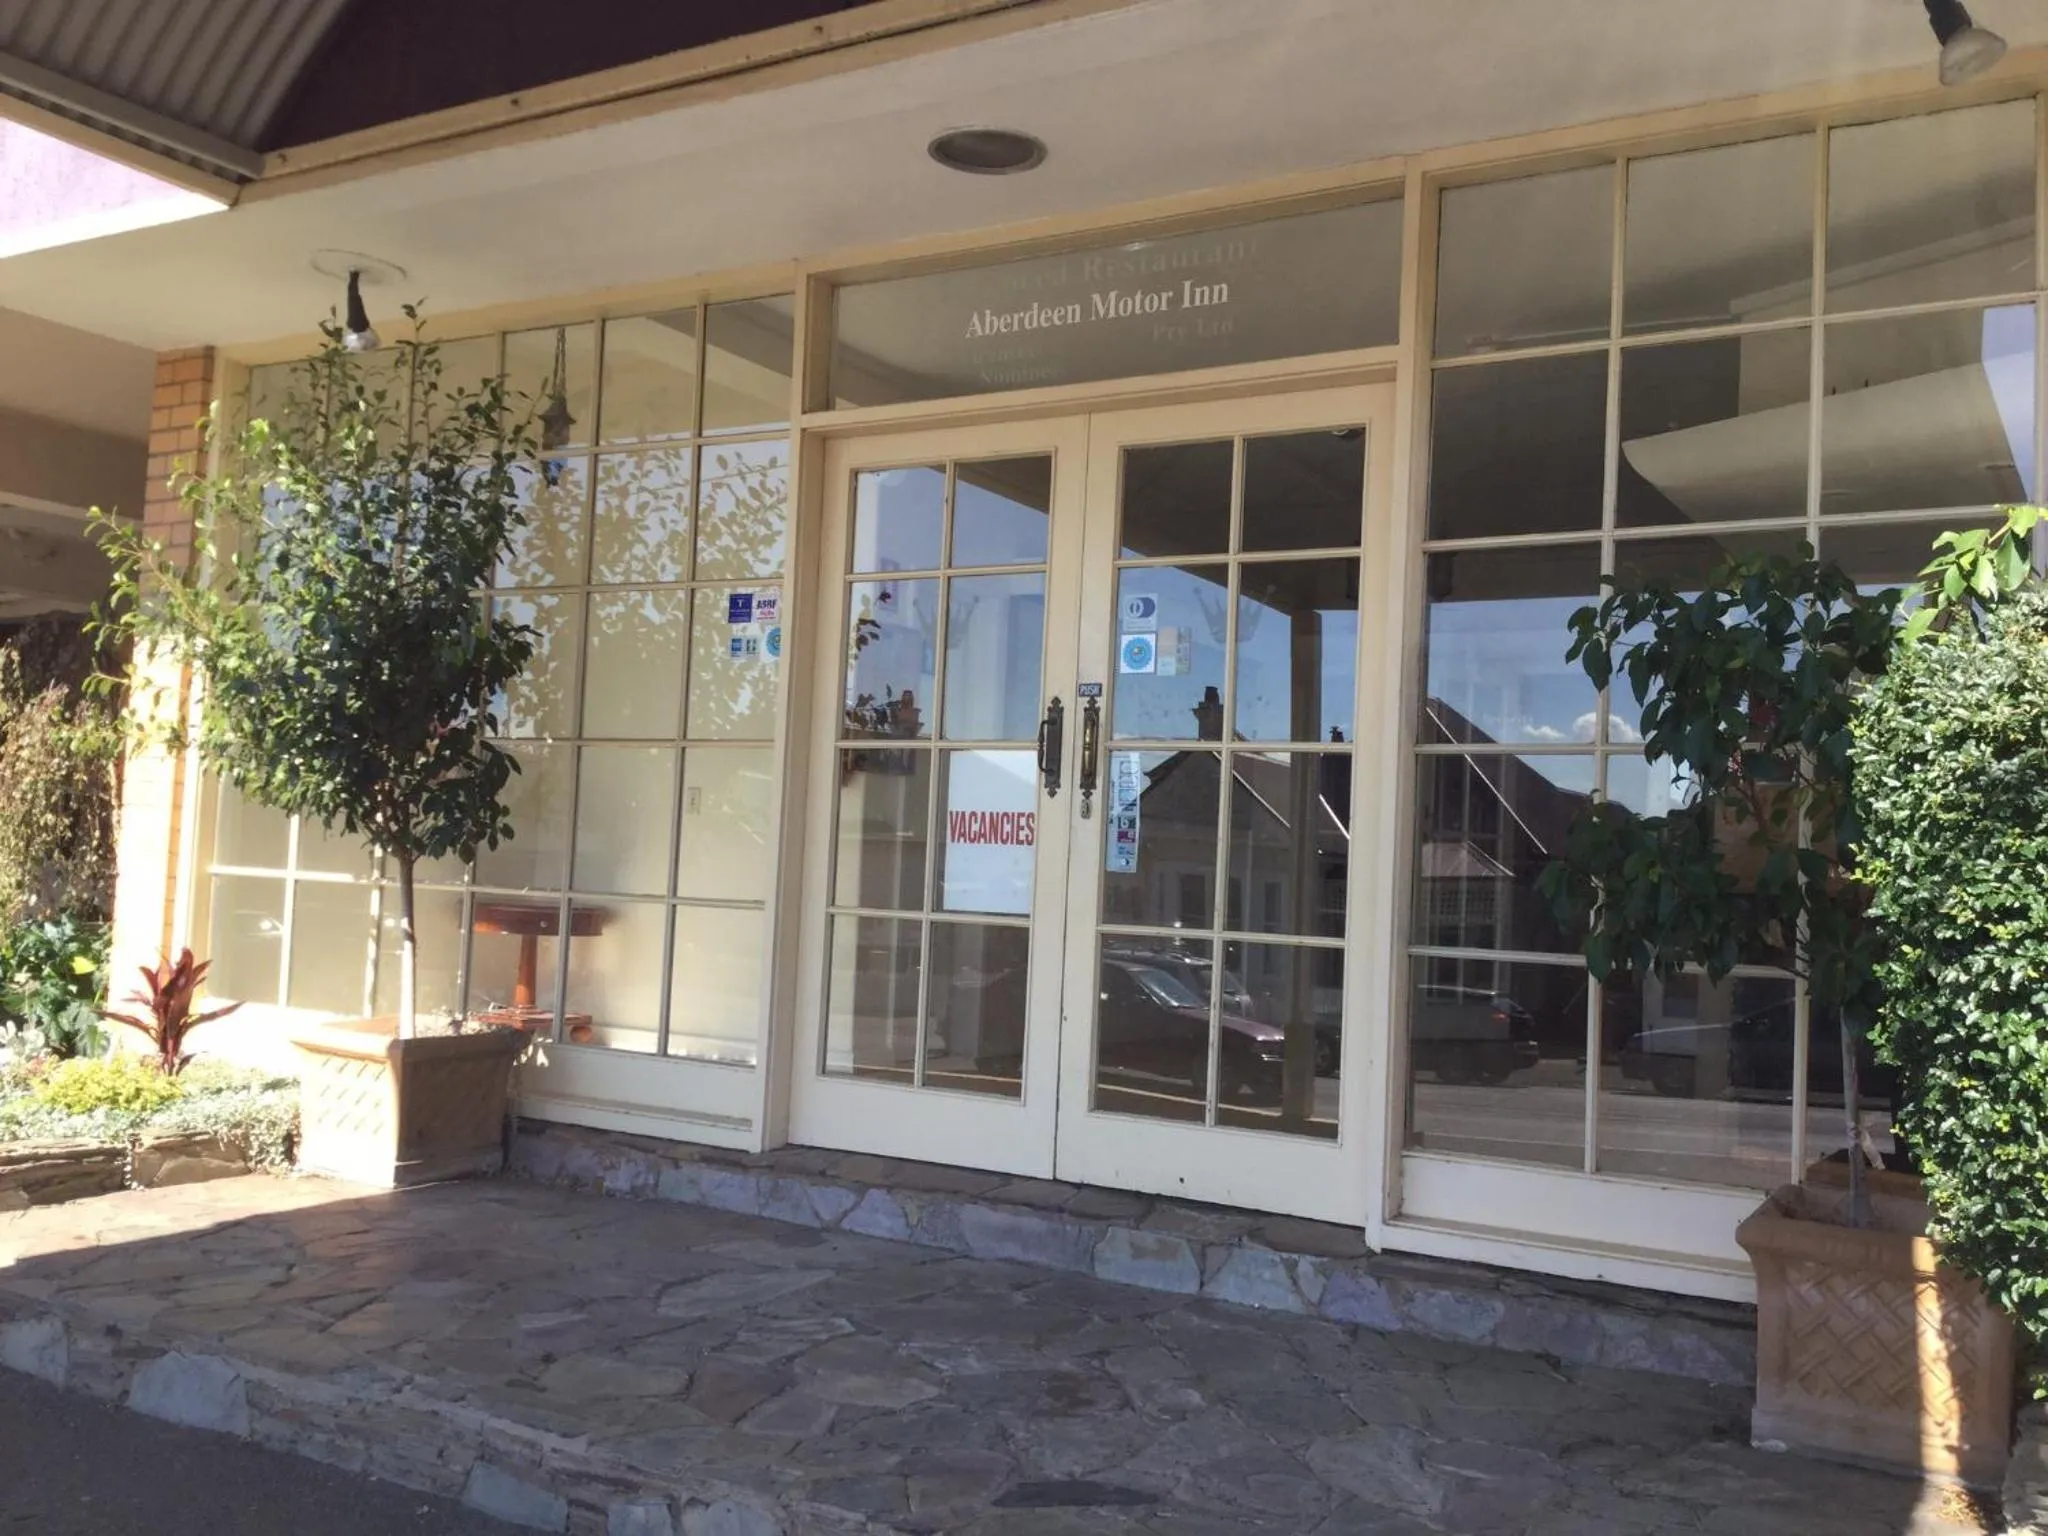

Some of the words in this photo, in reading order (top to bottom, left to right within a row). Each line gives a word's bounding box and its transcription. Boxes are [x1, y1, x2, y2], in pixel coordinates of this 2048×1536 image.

[964, 302, 1082, 339] Aberdeen
[1089, 289, 1174, 322] Motor
[1181, 278, 1230, 309] Inn
[1080, 684, 1100, 696] PUSH
[949, 811, 1036, 846] VACANCIES
